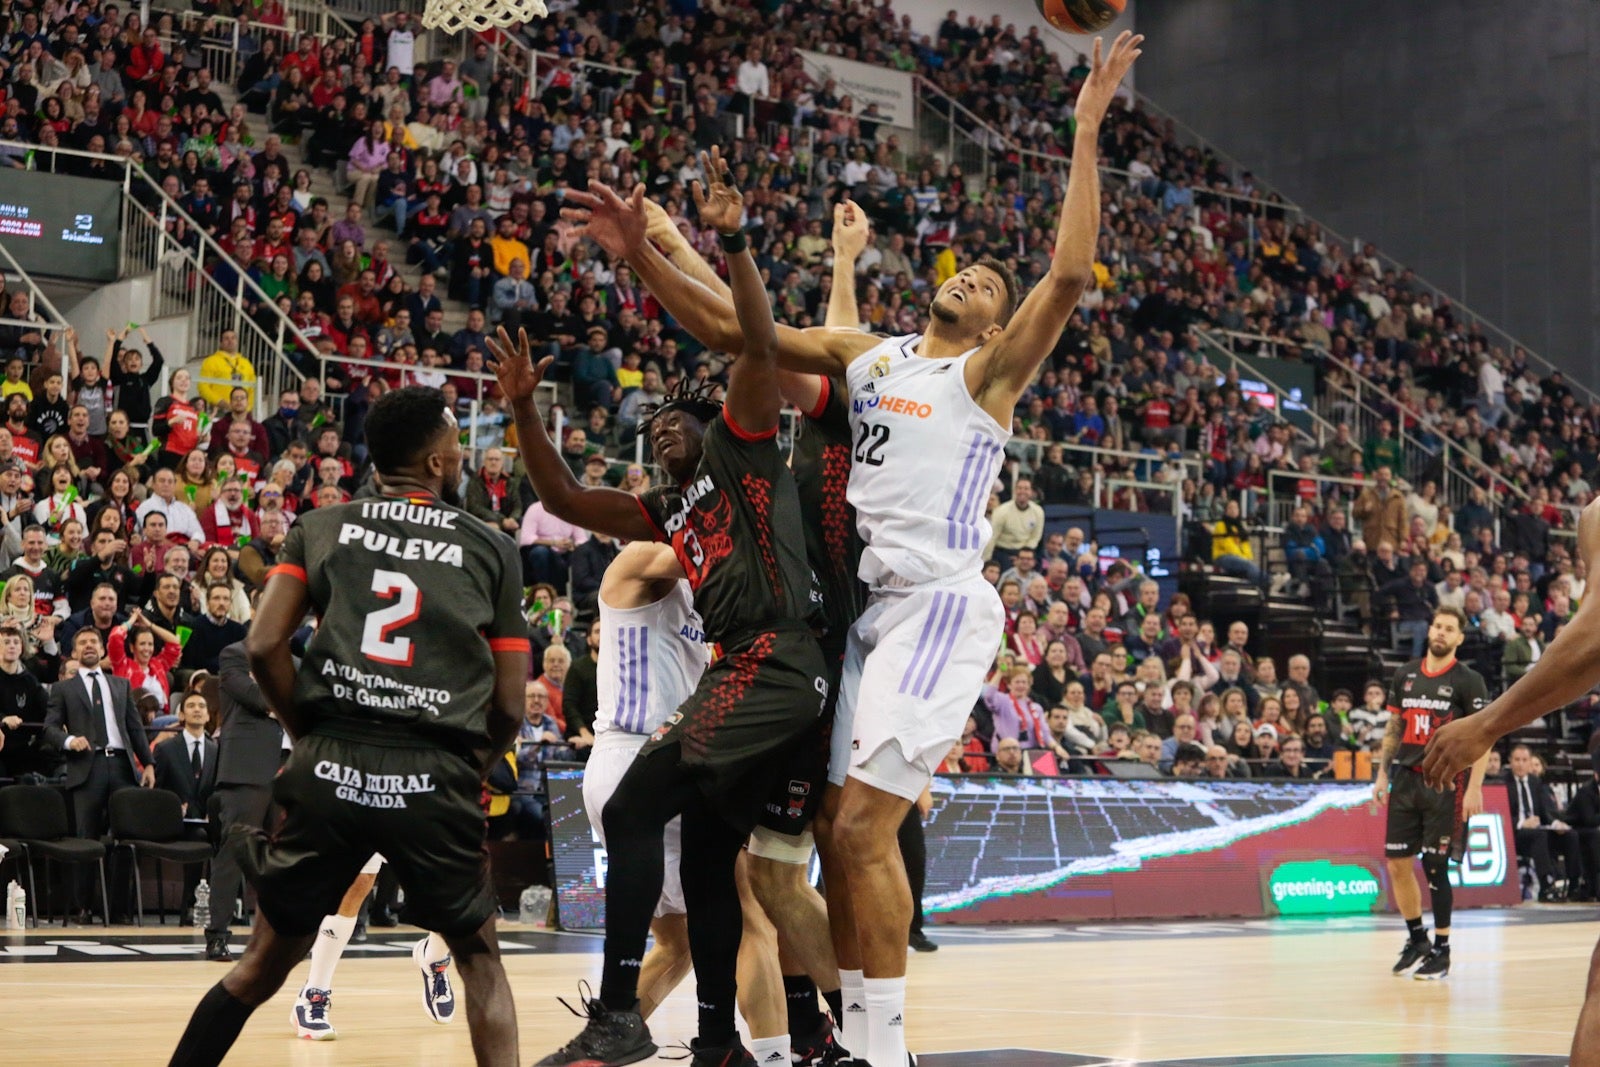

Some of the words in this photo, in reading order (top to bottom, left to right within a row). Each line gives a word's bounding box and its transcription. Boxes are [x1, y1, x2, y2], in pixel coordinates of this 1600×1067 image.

[853, 394, 933, 419] AOHERO
[855, 421, 890, 467] 22
[338, 522, 463, 568] PULEVA
[360, 568, 422, 667] 2
[321, 658, 451, 704] AYUNTAMENTO
[333, 683, 353, 701] DE
[1414, 713, 1431, 736] 14
[314, 760, 362, 788] CAJA
[365, 773, 436, 794] RURAL
[335, 785, 407, 809] GRNADA
[1273, 876, 1378, 901] greening-e.com
